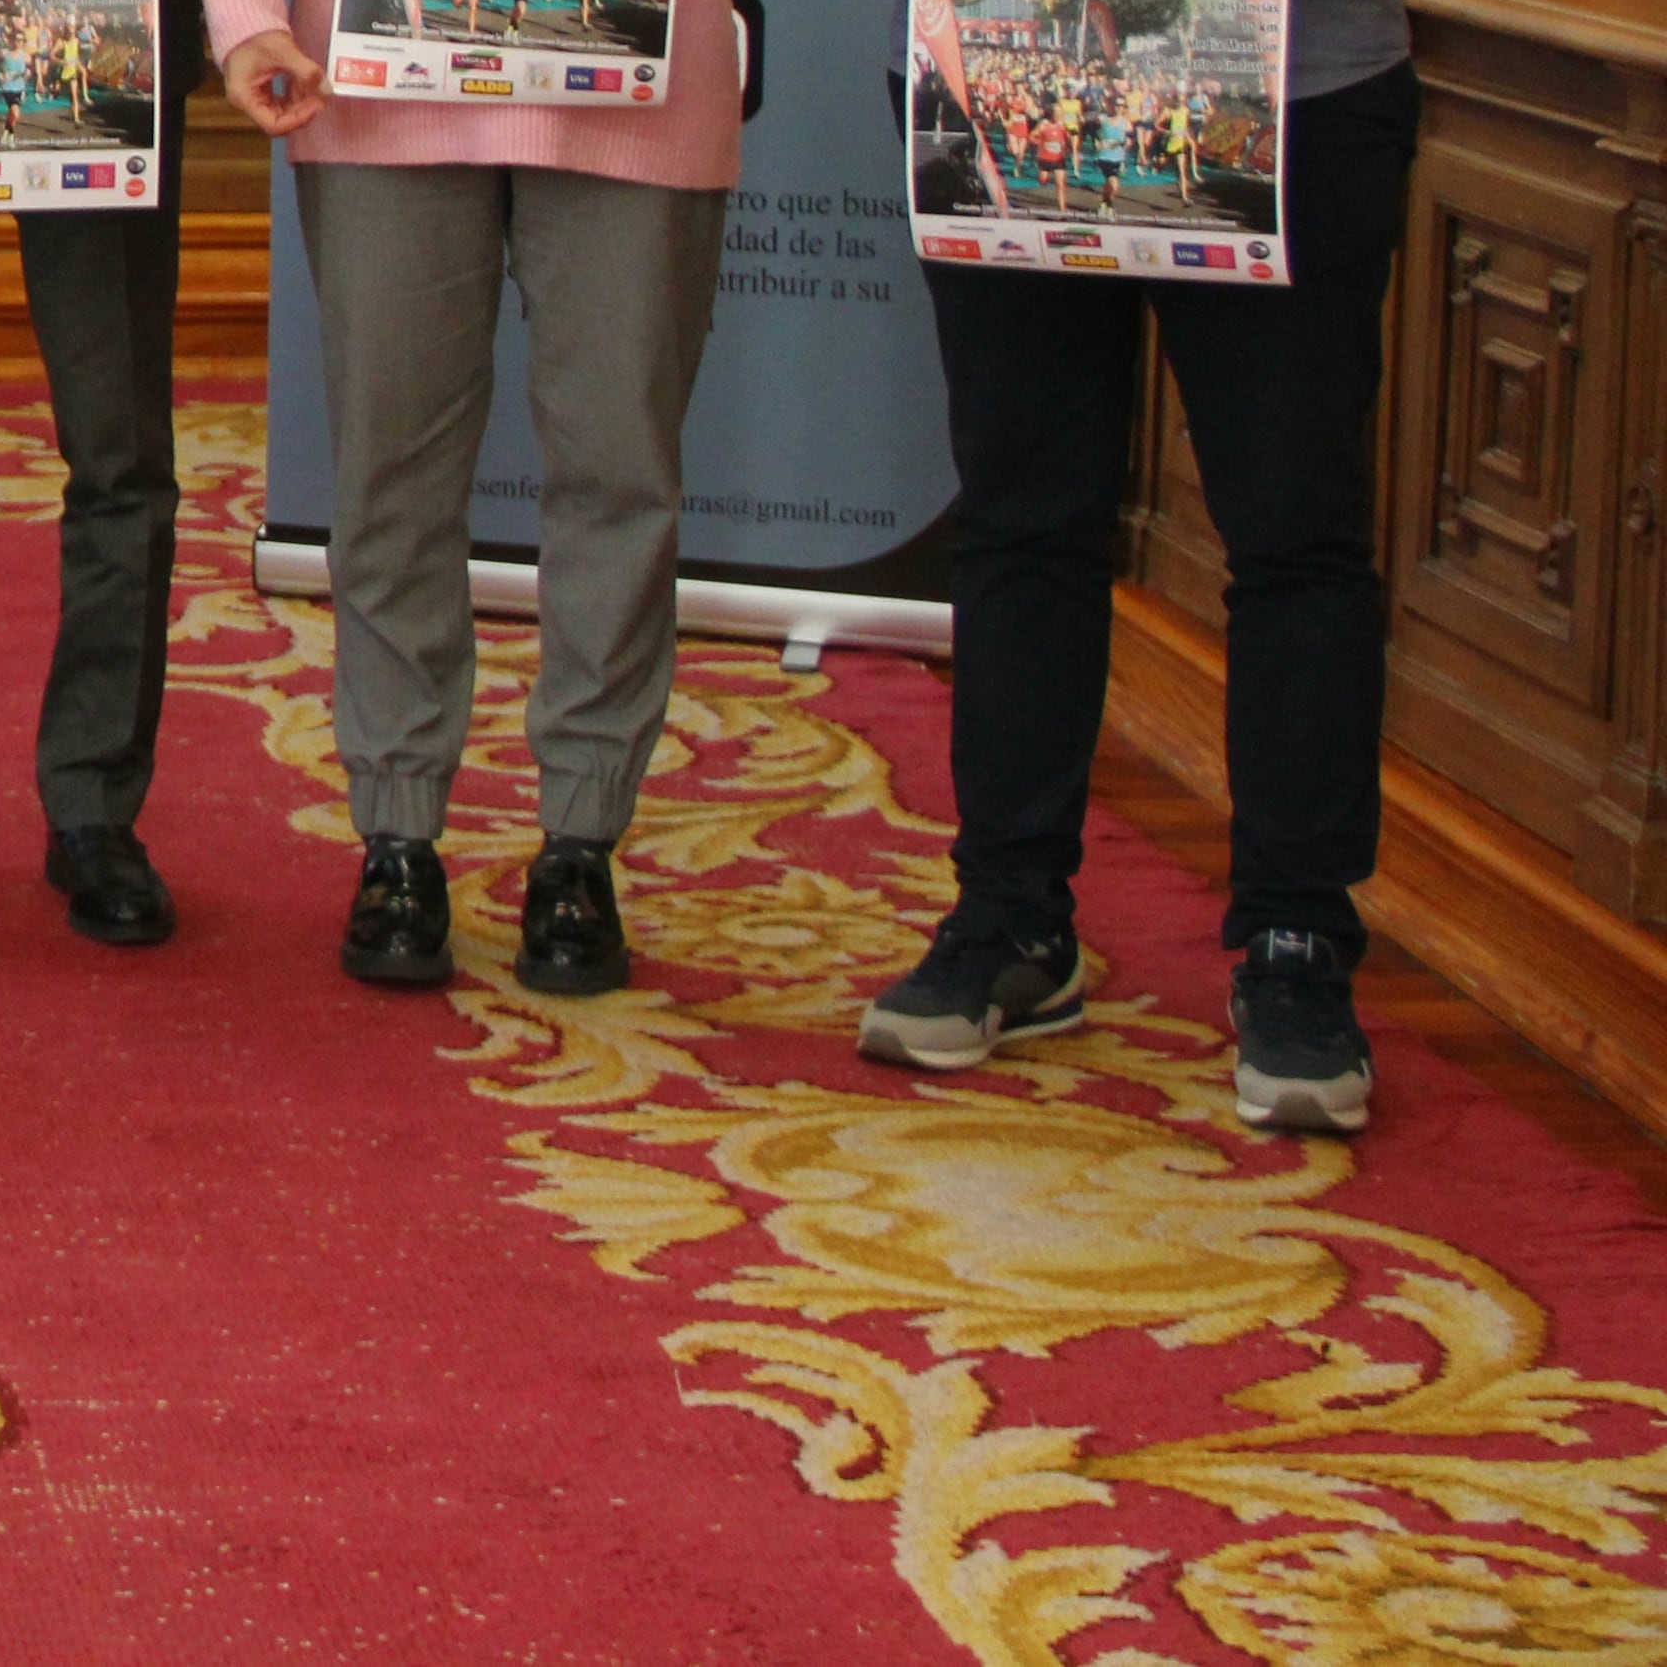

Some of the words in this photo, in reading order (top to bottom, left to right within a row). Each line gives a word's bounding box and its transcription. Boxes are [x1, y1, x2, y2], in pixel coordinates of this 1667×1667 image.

[778, 191, 832, 221] que
[788, 229, 824, 256] de
[835, 230, 877, 258] las
[830, 278, 847, 299] a
[856, 281, 890, 302] su
